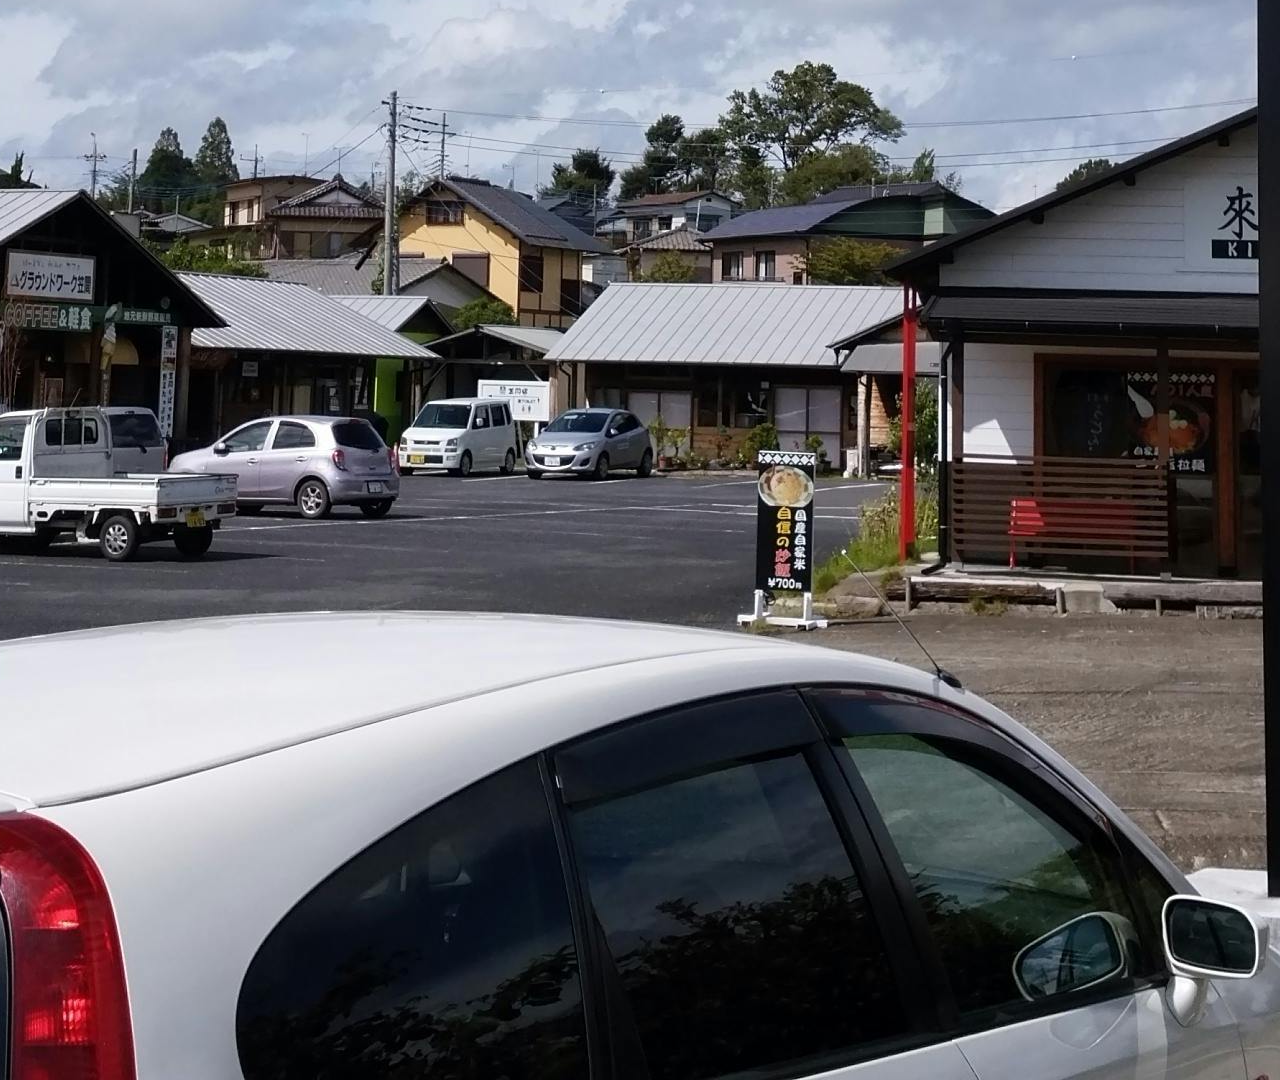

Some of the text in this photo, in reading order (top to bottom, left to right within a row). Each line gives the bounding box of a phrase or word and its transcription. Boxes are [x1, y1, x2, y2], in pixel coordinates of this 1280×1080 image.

[19, 271, 91, 294] グラウンドワーク笠間
[775, 507, 791, 577] 自信の炒飯
[794, 510, 807, 570] 国産自家米
